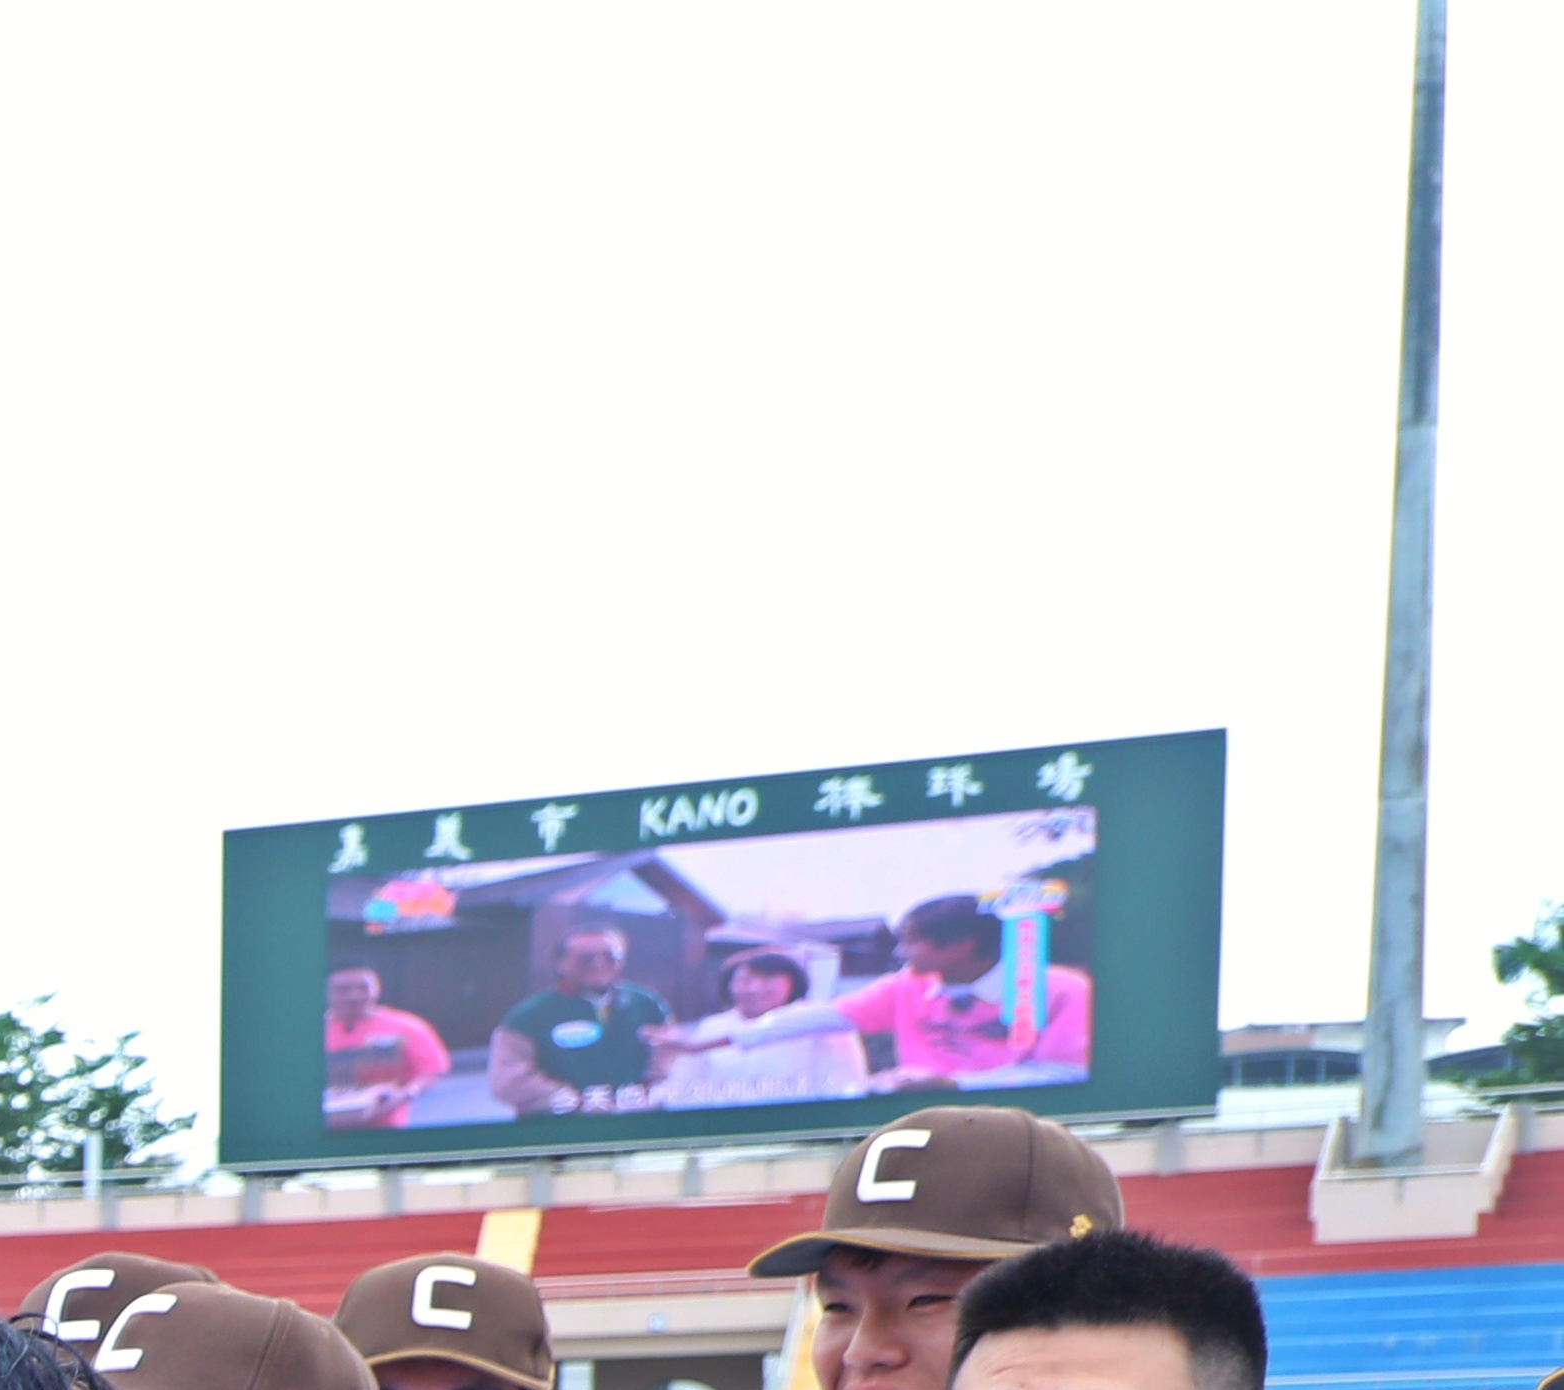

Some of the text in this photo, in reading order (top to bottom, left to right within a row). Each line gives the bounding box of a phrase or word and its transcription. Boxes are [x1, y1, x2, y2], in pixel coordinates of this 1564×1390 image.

[640, 787, 759, 841] KANO
[812, 751, 1093, 821] 棒球場
[856, 1128, 930, 1203] C
[412, 1265, 477, 1330] C
